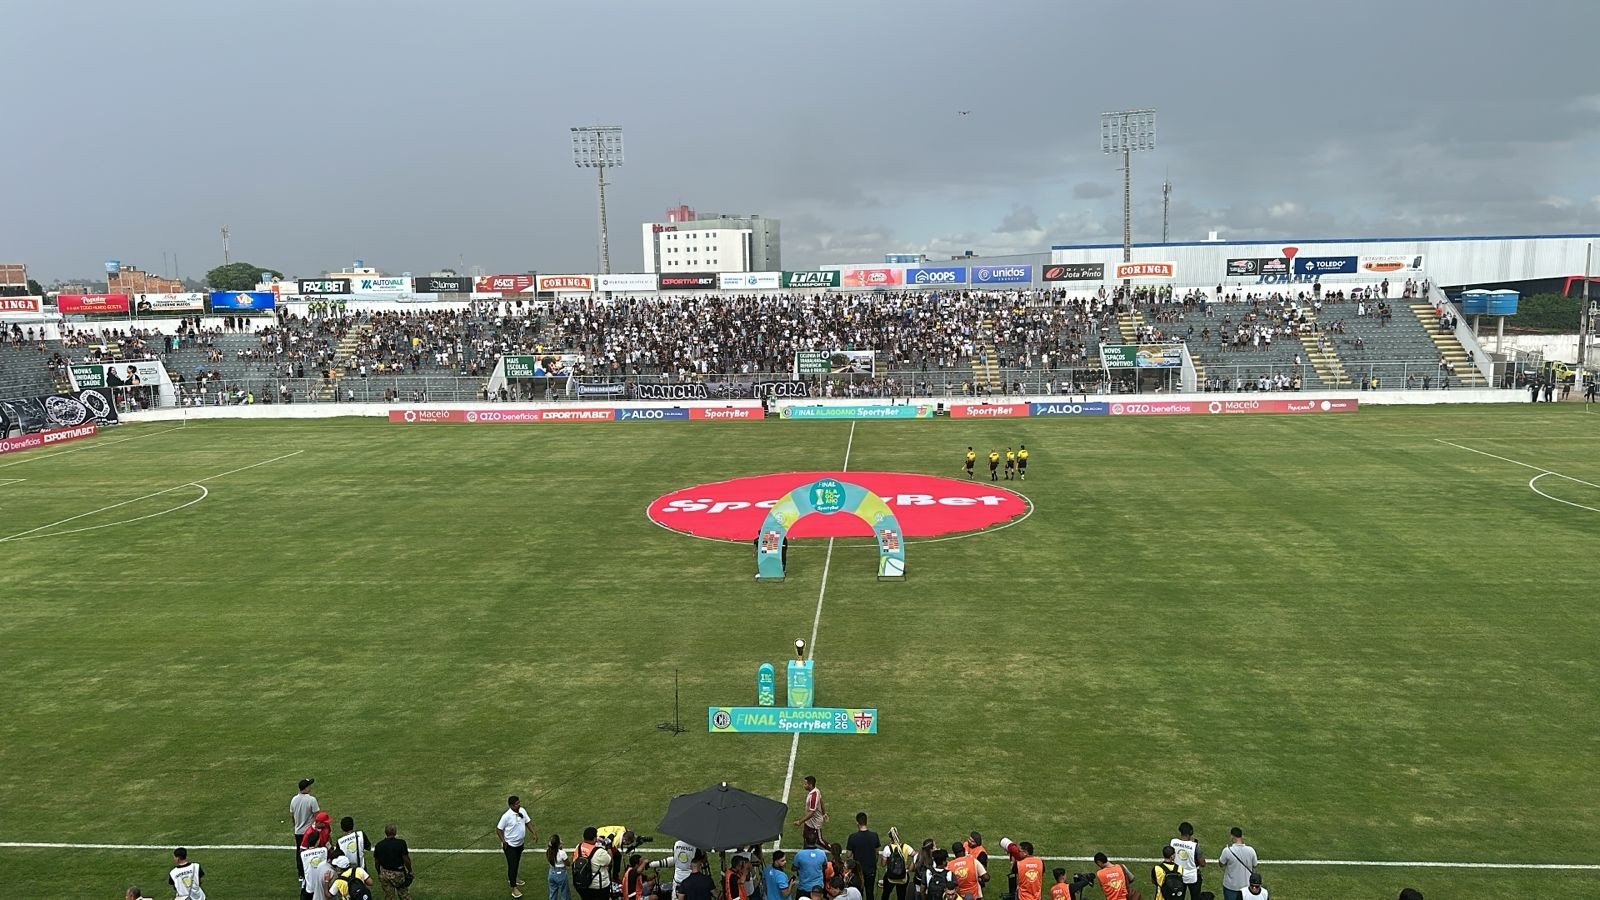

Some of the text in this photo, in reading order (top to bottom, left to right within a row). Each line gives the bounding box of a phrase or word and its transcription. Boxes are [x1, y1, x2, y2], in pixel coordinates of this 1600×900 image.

[992, 267, 1025, 278] unidos
[1120, 265, 1169, 275] CORINGA
[790, 271, 834, 283] TAL
[929, 271, 956, 281] OOPS
[543, 277, 588, 287] CORINGA
[73, 367, 93, 375] NOVAS
[638, 384, 708, 399] MANCHA
[753, 382, 807, 399] NEGRA
[1047, 404, 1082, 414] ALOO
[1126, 404, 1150, 413] azo
[1225, 400, 1259, 409] Maceió
[419, 410, 450, 418] Maceió
[479, 412, 501, 420] azo
[631, 410, 664, 419] ALOO
[704, 408, 749, 419] SportyBet
[815, 408, 856, 416] ALAGOANO
[857, 407, 900, 419] SportyBet
[966, 406, 1013, 417] SportyBet
[736, 713, 777, 726] FINAL
[778, 711, 832, 719] ALAGOANO
[834, 713, 848, 721] 20
[778, 719, 848, 731] SportyBet 26
